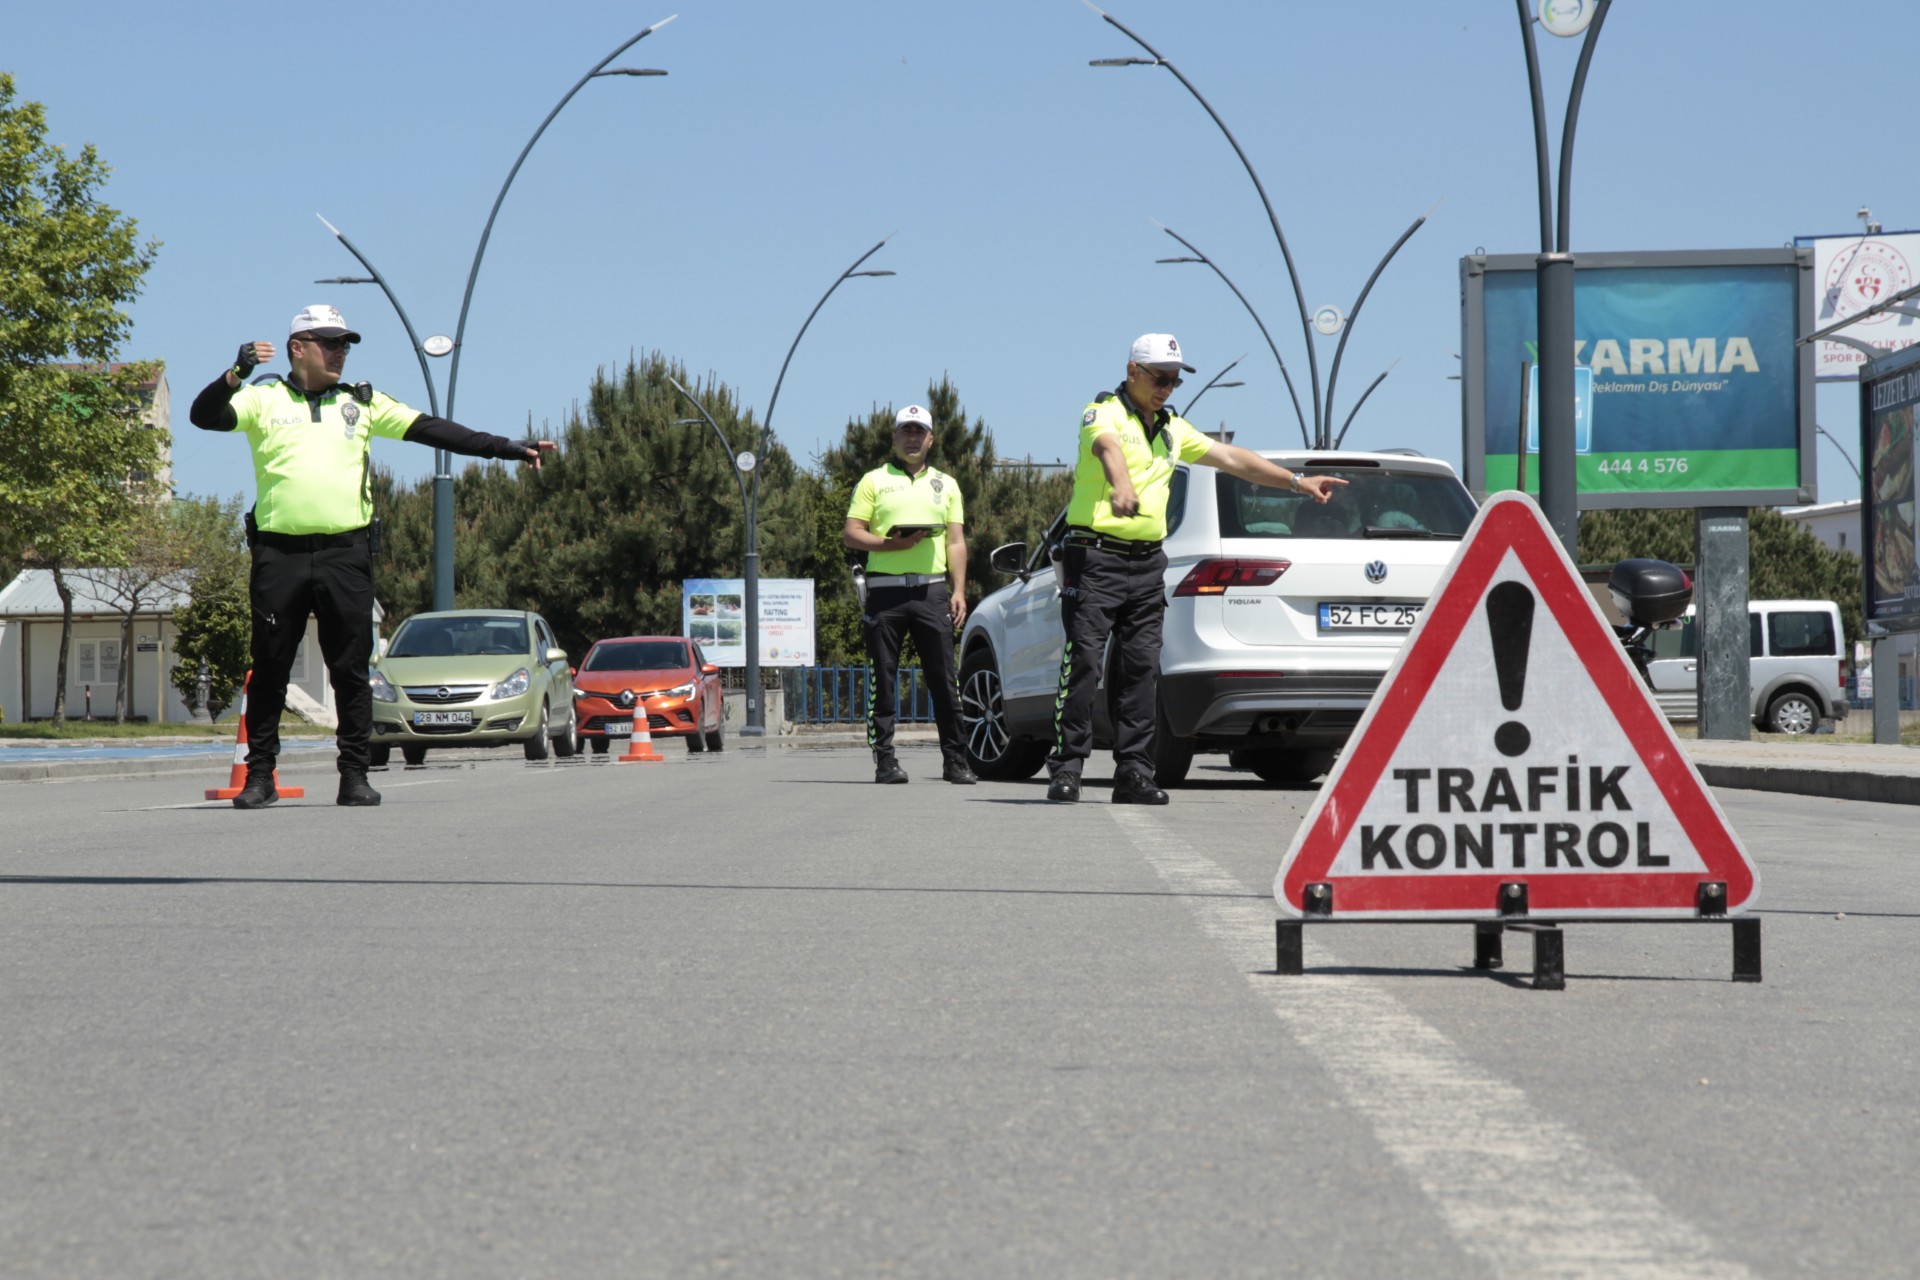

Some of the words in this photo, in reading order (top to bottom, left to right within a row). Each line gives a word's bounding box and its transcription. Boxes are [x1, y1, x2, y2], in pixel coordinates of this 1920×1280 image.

[1823, 354, 1853, 363] SPOR
[1649, 380, 1669, 394] Dış
[1873, 375, 1907, 411] LEZZETE
[1598, 459, 1632, 474] 444
[1638, 459, 1649, 473] 4
[1654, 458, 1689, 473] 576
[1330, 606, 1353, 625] 52
[1360, 606, 1388, 625] FC
[420, 713, 432, 722] 28
[1393, 755, 1633, 813] TRAFİK
[1361, 821, 1670, 870] KONTROL
